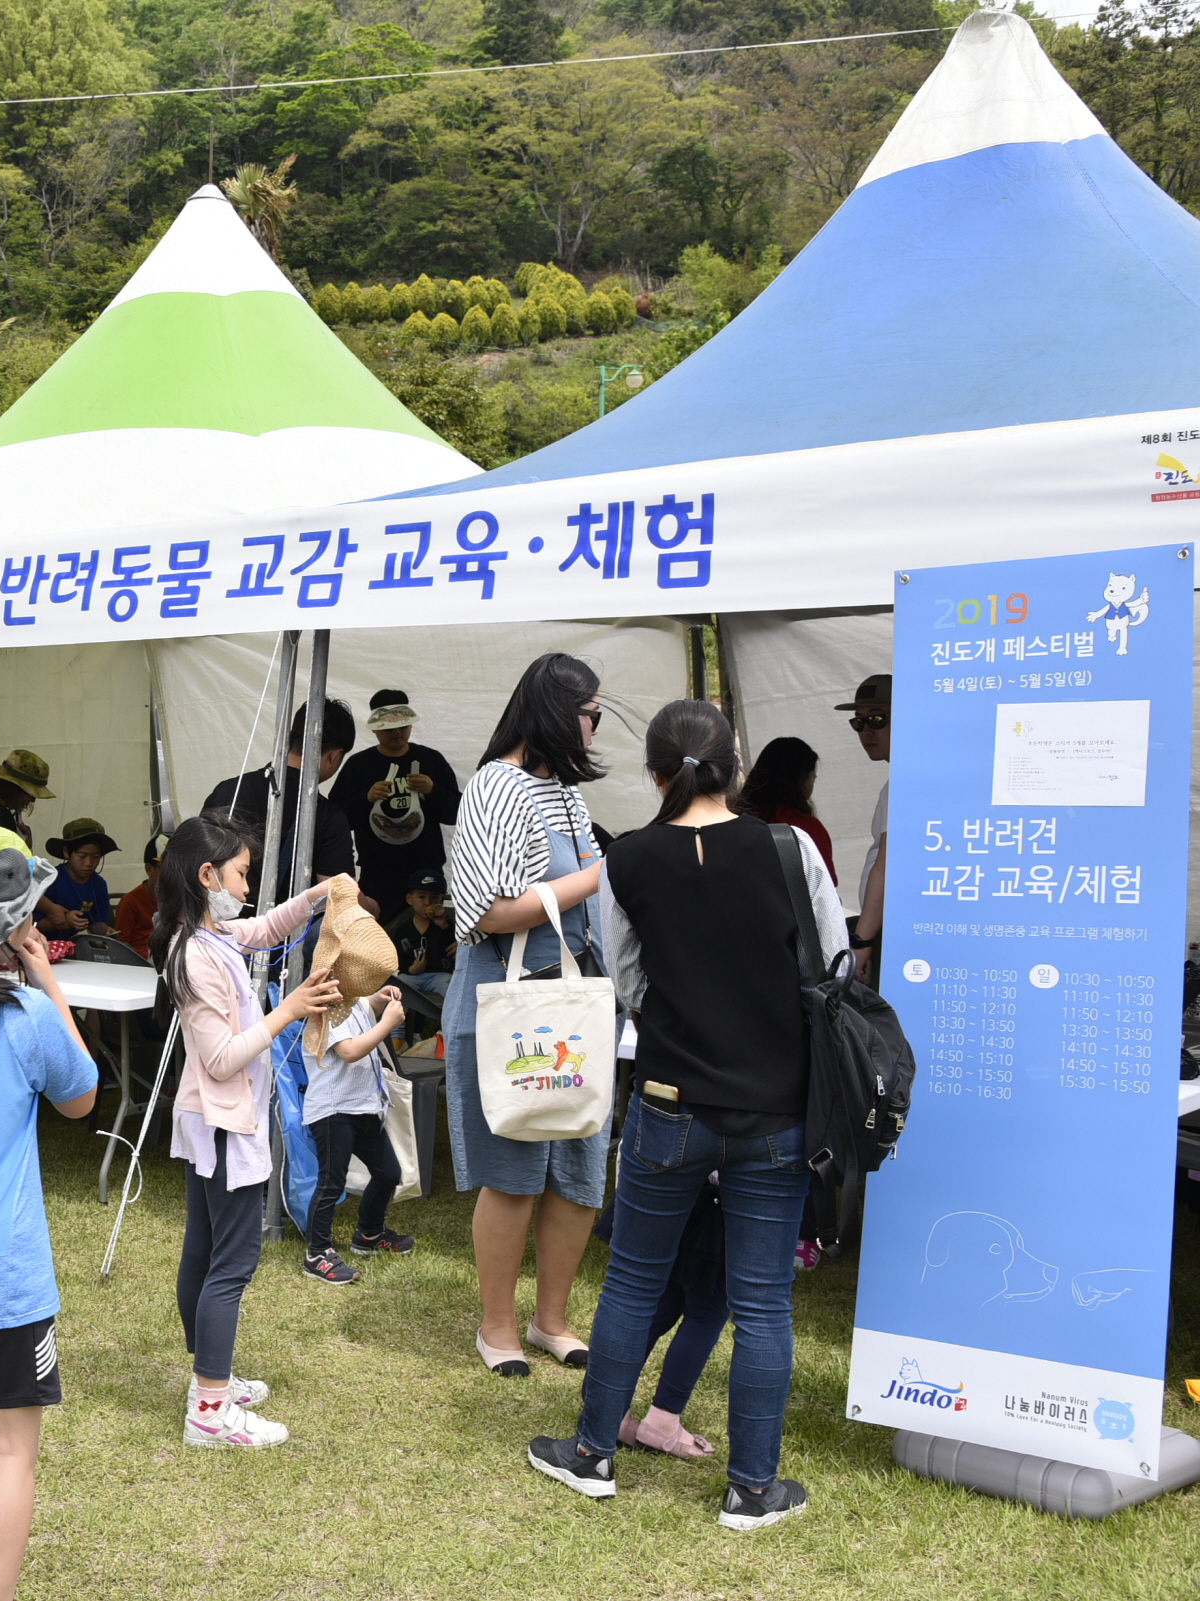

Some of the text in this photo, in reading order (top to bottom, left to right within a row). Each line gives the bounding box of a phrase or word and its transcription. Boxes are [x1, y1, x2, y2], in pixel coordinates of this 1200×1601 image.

[0, 540, 212, 626] 반려동물
[225, 528, 358, 609] 교감
[933, 592, 1029, 629] 2019
[930, 631, 1095, 666] 진도개 페스티벌
[933, 678, 955, 693] 5월
[957, 674, 1003, 692] 4일(토)
[1020, 672, 1042, 688] 5월
[1044, 670, 1092, 688] 5일(일)
[396, 798, 407, 808] 20
[924, 817, 1057, 854] 5. 반려견
[921, 865, 1142, 904] 교감 교육/체험
[913, 922, 1148, 941] 반려견 이해 및 생명존중 교육 프로그램 체험하기
[934, 967, 968, 980] 10:30
[983, 969, 1017, 982] 10:50
[1064, 972, 1100, 986] 10:30
[1117, 974, 1154, 988] 10:50
[933, 983, 967, 996] 11:10
[982, 985, 1016, 999] 11:30
[1063, 989, 1100, 1003] 11:10
[1116, 992, 1153, 1006] 11:30
[933, 999, 966, 1012] 11:50
[981, 1002, 1016, 1015] 12:10
[1062, 1006, 1098, 1020] 11:50
[1115, 1009, 1153, 1023] 12:10
[931, 1015, 965, 1029] 13:30
[981, 1018, 1015, 1032] 13:50
[1061, 1023, 1098, 1037] 13:30
[1115, 1027, 1152, 1041] 13:50
[931, 1032, 964, 1045] 14:10
[980, 1035, 1014, 1049] 14:30
[1060, 1040, 1097, 1054] 14:10
[1114, 1044, 1152, 1058] 14:30
[930, 1048, 963, 1062] 14:50
[979, 1052, 1013, 1066] 15:10
[929, 1064, 962, 1078] 15:30
[978, 1068, 1012, 1082] 15:50
[1060, 1057, 1096, 1072] 14:50
[1113, 1061, 1150, 1076] 15:10
[536, 1074, 584, 1090] JINDO
[928, 1081, 961, 1095] 16:10
[977, 1085, 1011, 1099] 16:30
[1059, 1074, 1095, 1089] 15:30
[1112, 1079, 1150, 1093] 15:50
[880, 1380, 952, 1409] Jindo
[1042, 1391, 1088, 1406] Nanum Virus
[1004, 1410, 1015, 1418] 10%
[1016, 1412, 1028, 1420] Love
[1068, 1423, 1088, 1432] Society
